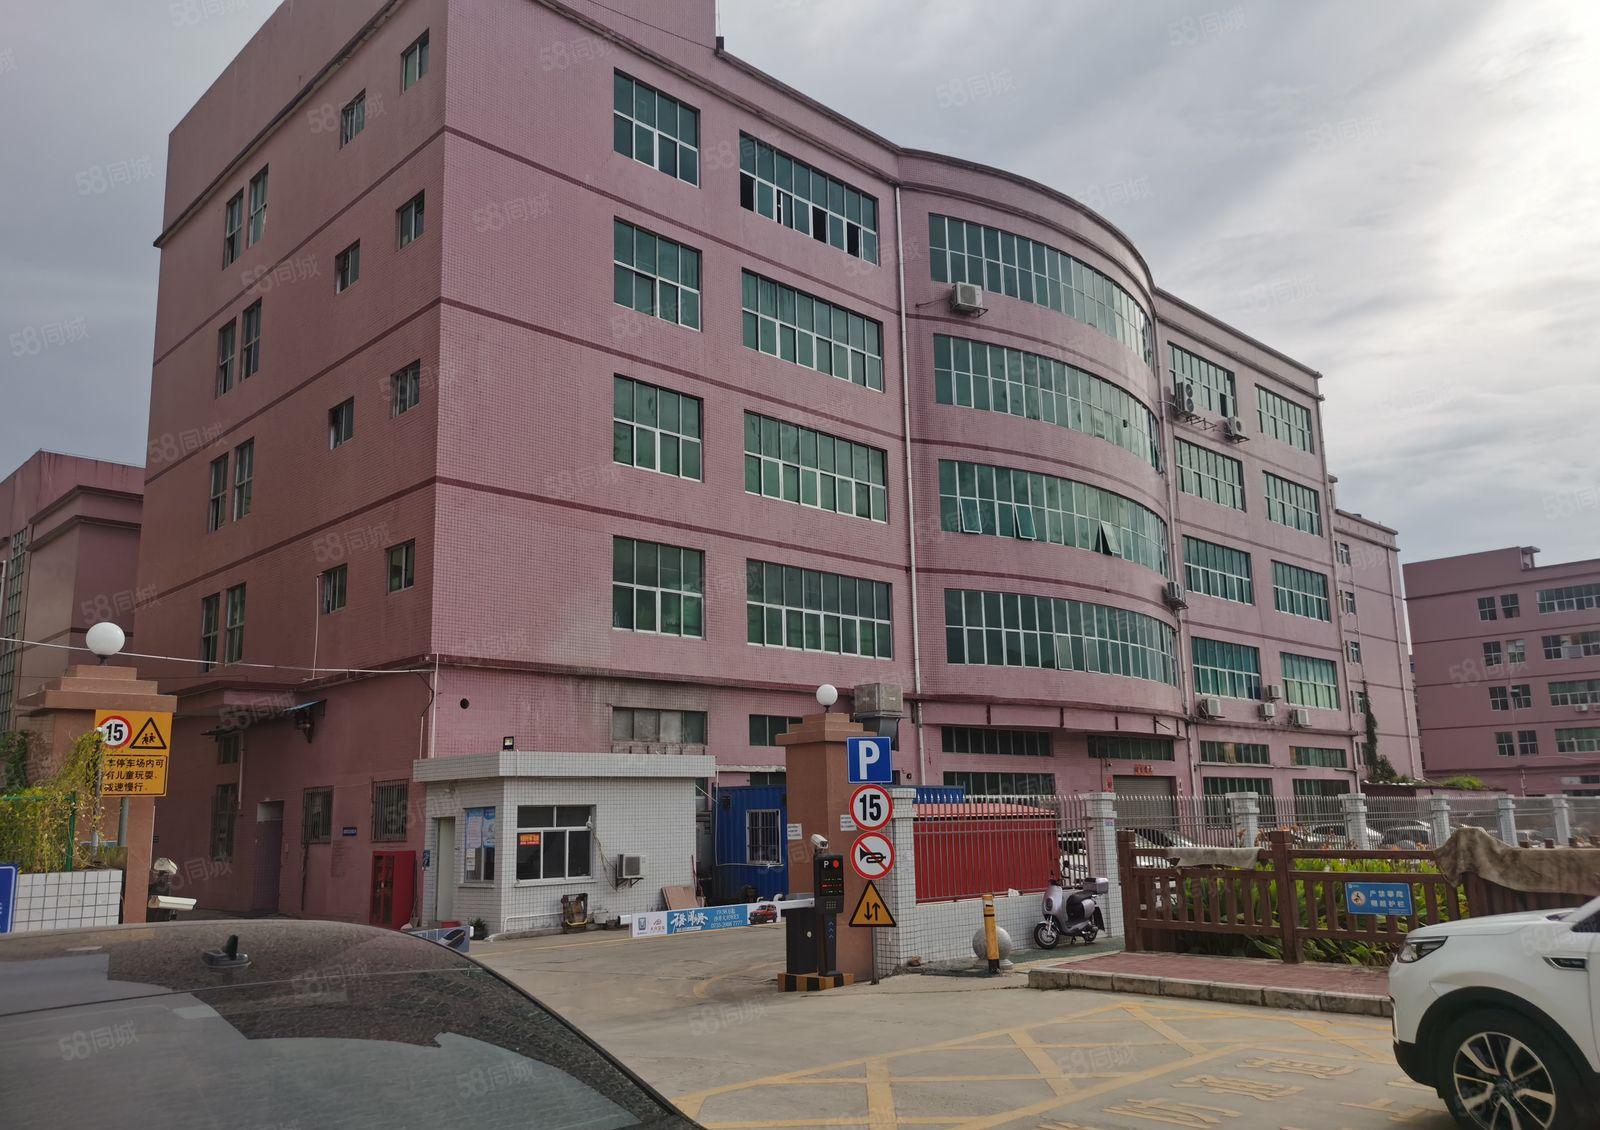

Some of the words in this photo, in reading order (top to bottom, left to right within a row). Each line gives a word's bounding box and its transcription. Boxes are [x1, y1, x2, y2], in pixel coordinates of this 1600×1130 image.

[106, 723, 124, 741] 15
[858, 740, 880, 780] P
[859, 794, 882, 821] 15
[823, 860, 830, 869] P
